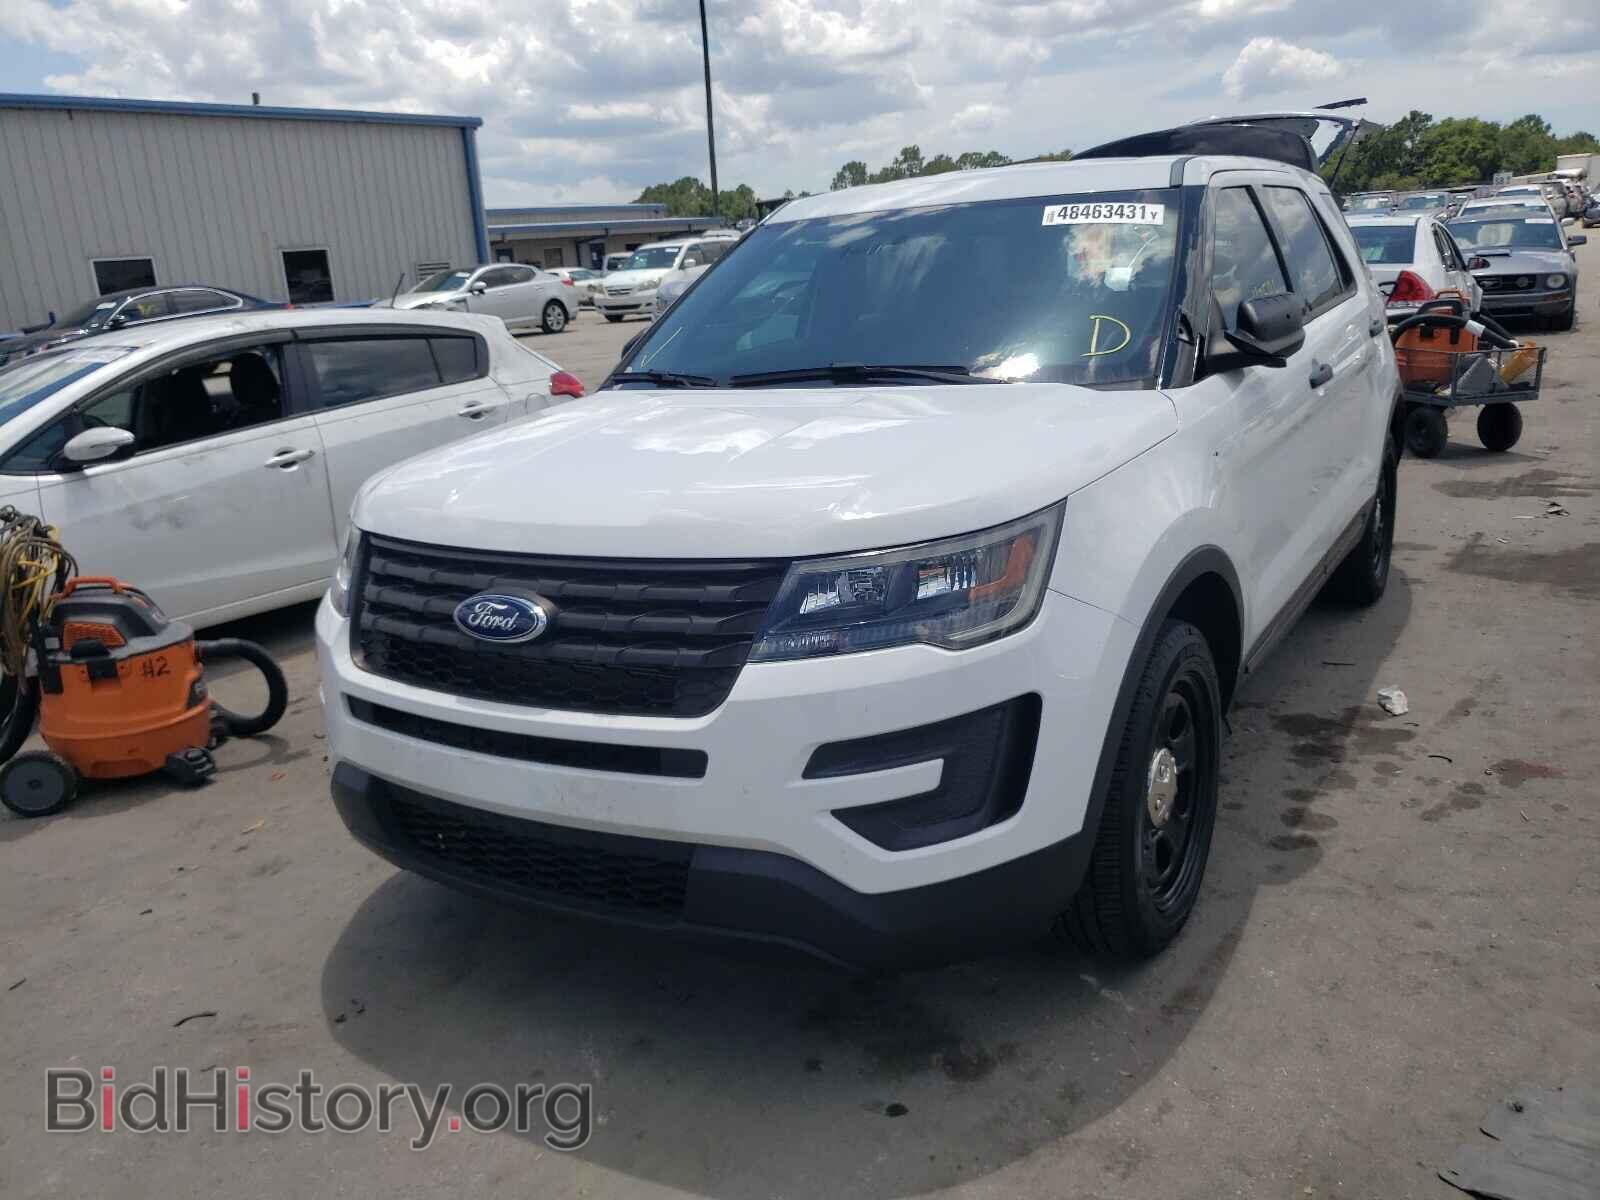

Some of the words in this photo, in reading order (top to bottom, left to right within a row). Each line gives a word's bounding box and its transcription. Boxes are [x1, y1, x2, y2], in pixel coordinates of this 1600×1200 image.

[1058, 204, 1147, 220] 48463431
[1080, 315, 1131, 357] D
[468, 601, 520, 631] Ford
